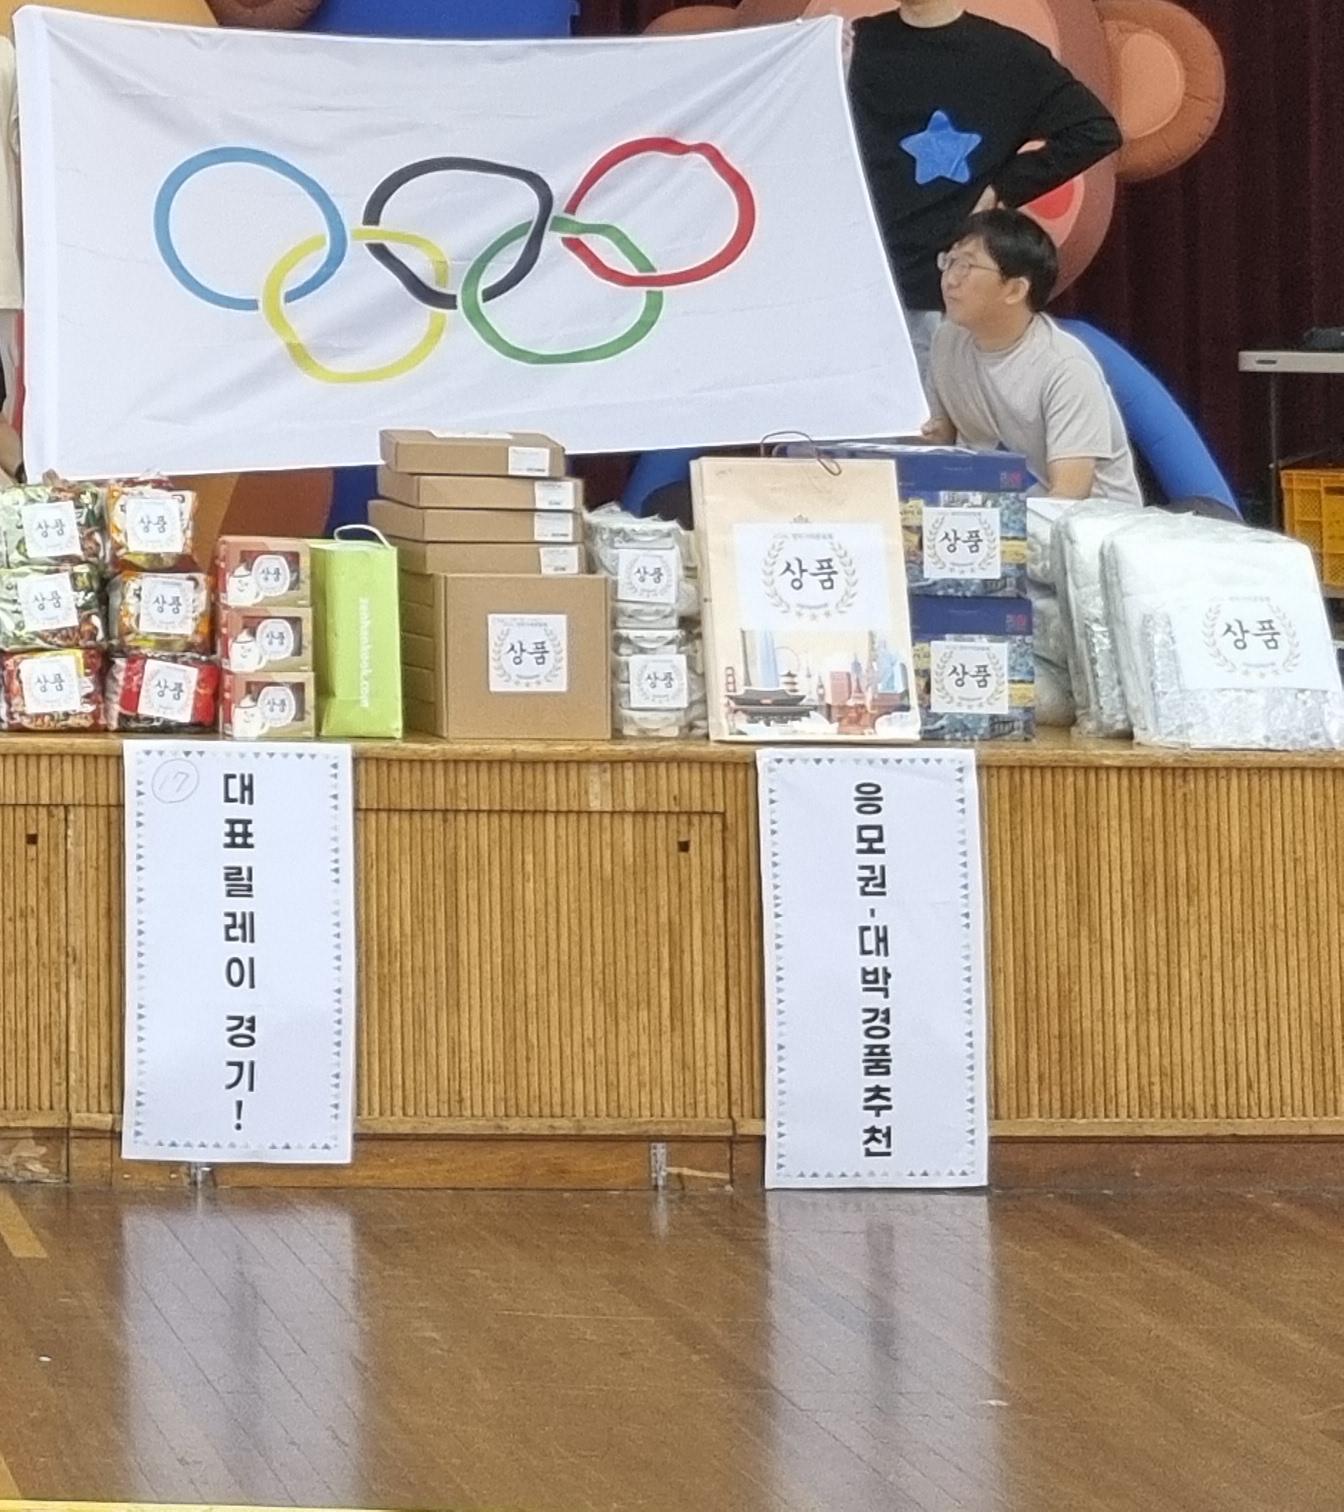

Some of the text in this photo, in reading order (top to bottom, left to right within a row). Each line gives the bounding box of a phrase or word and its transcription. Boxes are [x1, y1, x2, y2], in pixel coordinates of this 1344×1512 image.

[940, 529, 983, 553] 상품
[781, 558, 838, 590] 상품
[1223, 619, 1281, 650] 상품
[507, 641, 549, 665] 상품
[948, 664, 991, 688] 상품
[222, 772, 257, 1131] 대표릴레이 경기!
